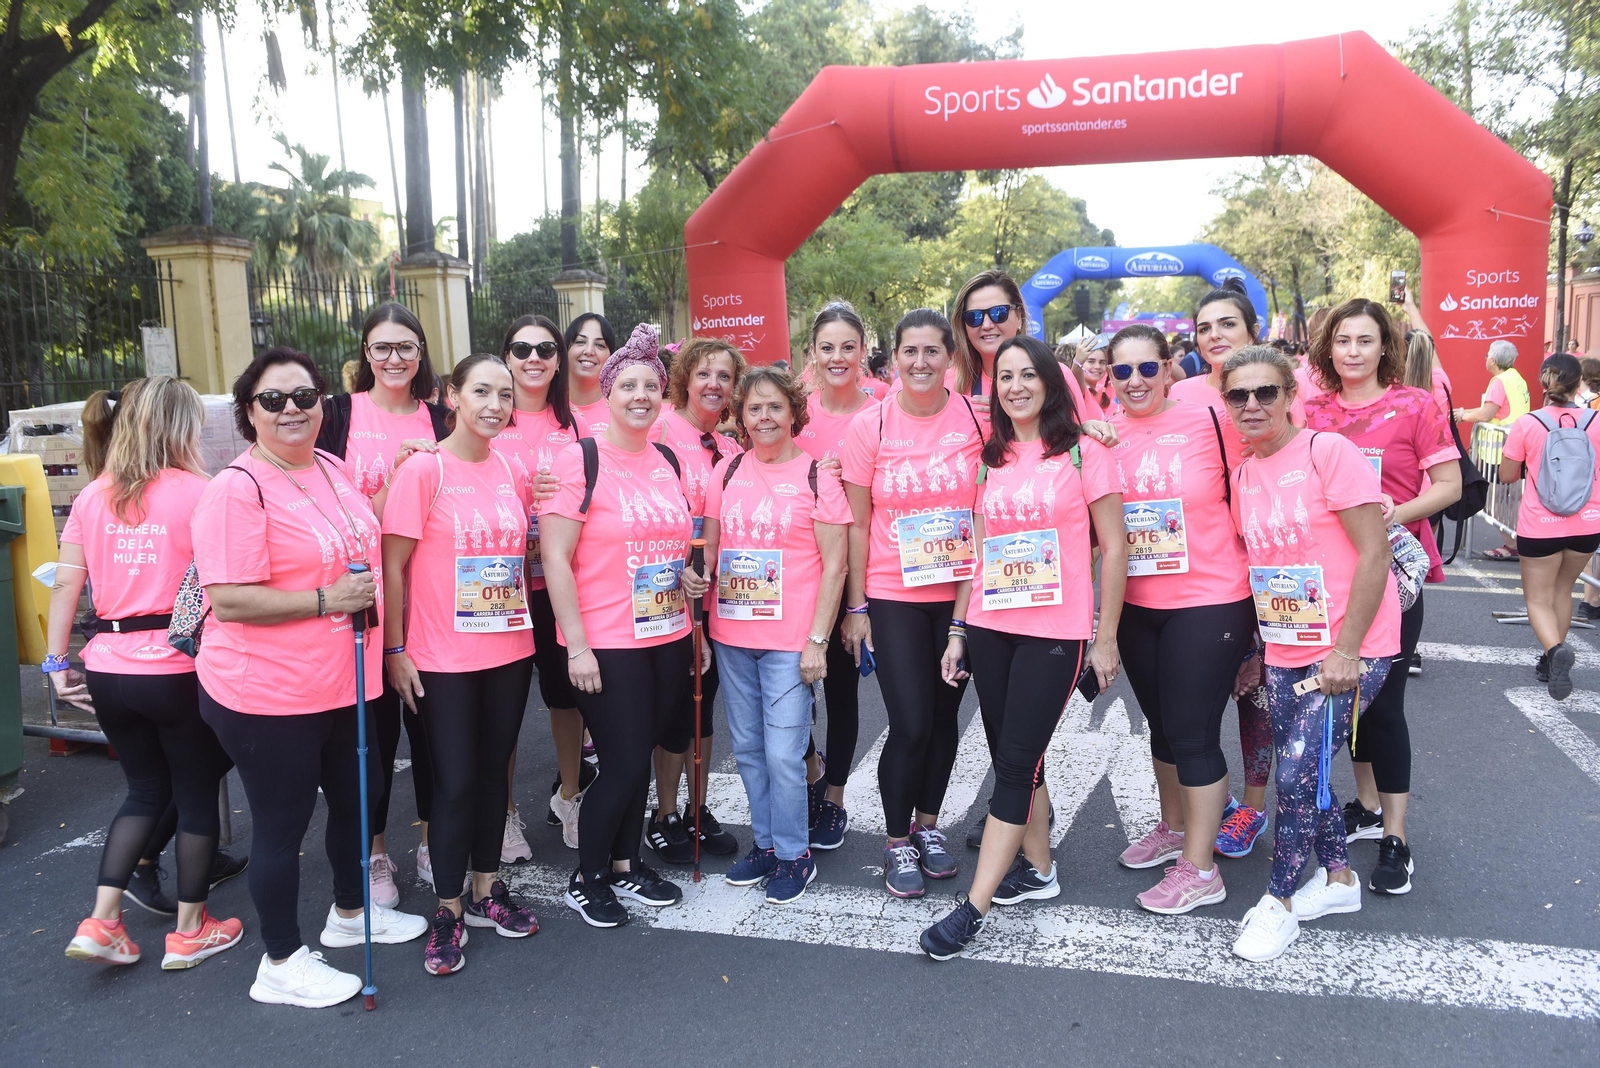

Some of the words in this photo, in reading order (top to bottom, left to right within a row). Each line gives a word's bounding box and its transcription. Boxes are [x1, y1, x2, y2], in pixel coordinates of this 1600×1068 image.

[924, 85, 1021, 121] Sports
[1072, 69, 1243, 106] Santander
[1021, 118, 1127, 136] sportssantander.es
[1130, 261, 1179, 272] ASTURIANA
[1466, 269, 1520, 288] Sports
[703, 294, 743, 310] Sports
[1460, 293, 1539, 311] Santander
[702, 314, 765, 330] Santander
[353, 431, 387, 440] OYSHO
[883, 437, 914, 447] OYSHO
[1359, 446, 1385, 456] ander
[728, 479, 754, 488] OYSHO
[442, 485, 475, 495] OYSHO
[287, 496, 317, 511] OYSHO
[1125, 516, 1158, 524] ASTURIANA
[105, 523, 167, 535] CARRERA
[922, 525, 953, 534] ASTURIANA
[1126, 530, 1159, 545] 016
[117, 538, 135, 549] DE
[138, 539, 154, 549] LA
[625, 541, 643, 552] TU
[648, 540, 686, 551] DORSA
[923, 539, 954, 554] 016
[1004, 546, 1034, 555] ASTURIANA
[114, 553, 157, 564] MUJER
[731, 562, 758, 570] ASTURIANA
[1003, 561, 1034, 577] 016
[910, 573, 935, 582] OYSHO
[730, 577, 757, 590] 016
[1270, 581, 1297, 589] ASTURIANA
[482, 586, 509, 600] 016
[655, 590, 676, 605] 016
[988, 597, 1012, 605] OYSHO
[1271, 597, 1298, 612] 016
[640, 625, 662, 633] OYSHO
